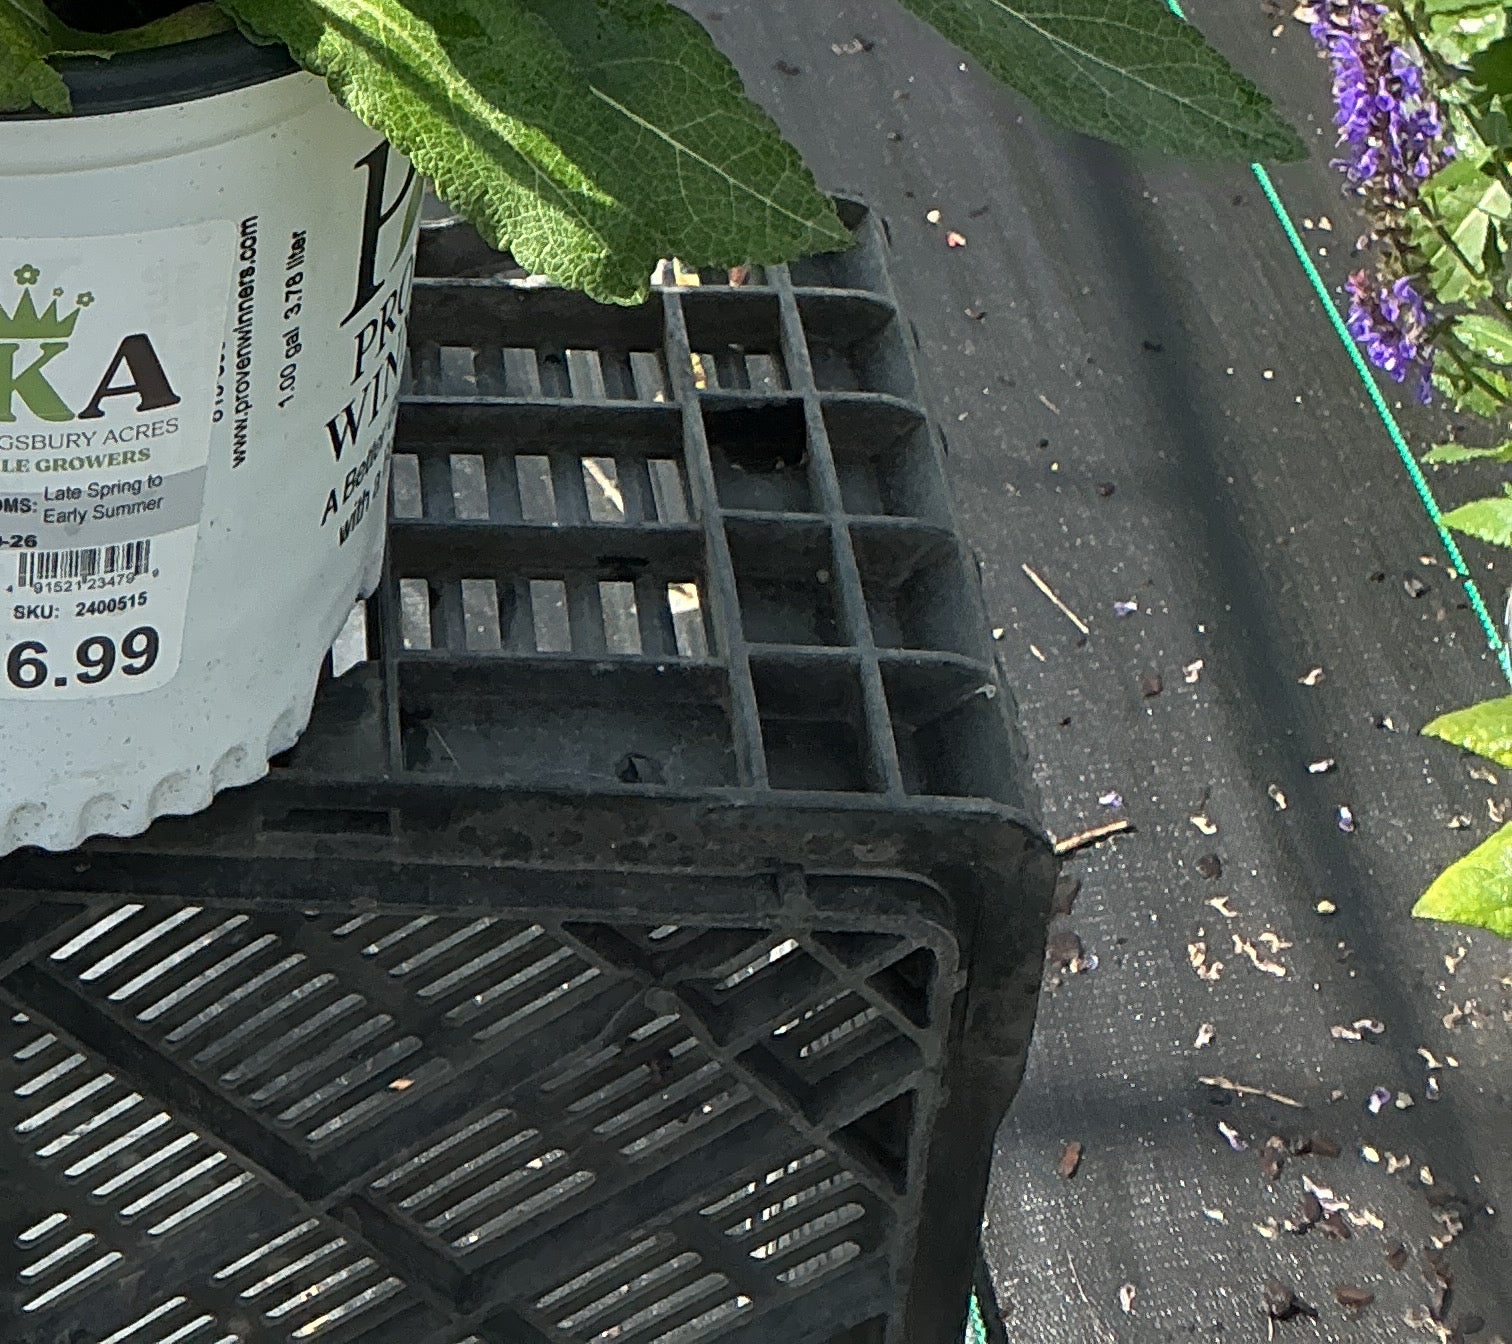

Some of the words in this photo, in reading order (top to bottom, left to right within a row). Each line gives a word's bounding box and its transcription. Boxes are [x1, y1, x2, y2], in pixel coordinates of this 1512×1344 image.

[286, 229, 307, 270] liter
[283, 271, 304, 320] 3.78
[232, 215, 259, 470] www.provenwinners.com
[282, 326, 303, 360] gal
[278, 363, 297, 408] 1.00
[102, 417, 180, 446] ACRES
[35, 446, 152, 473] GROWERS
[44, 486, 83, 502] Late
[87, 480, 143, 502] Spring
[147, 474, 164, 489] to
[44, 506, 89, 526] Early
[93, 496, 165, 521] Summer
[13, 604, 60, 621] SKU:
[75, 591, 148, 618] 2400515
